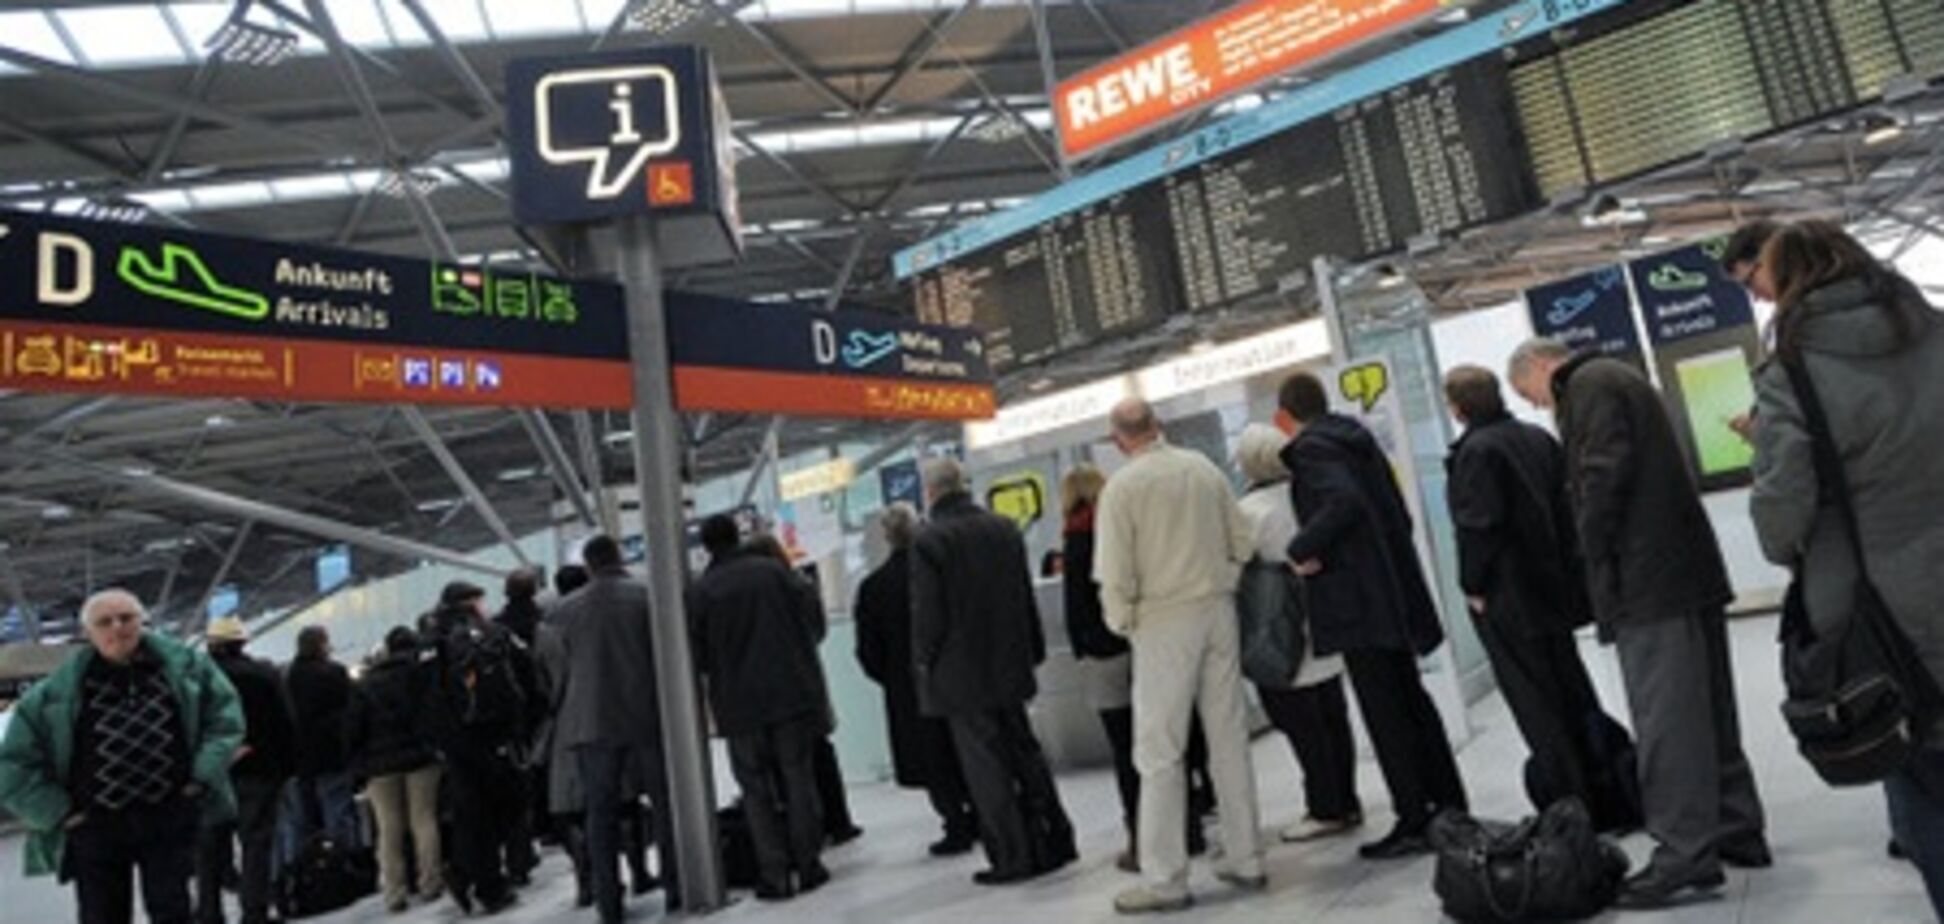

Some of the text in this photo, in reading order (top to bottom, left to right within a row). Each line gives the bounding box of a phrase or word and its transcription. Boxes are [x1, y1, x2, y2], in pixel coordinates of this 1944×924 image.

[1066, 42, 1198, 131] REWE
[1170, 76, 1211, 106] CITY
[37, 232, 93, 305] D
[275, 257, 394, 295] Ankunft
[275, 296, 389, 330] Arrivals
[812, 320, 836, 364] D
